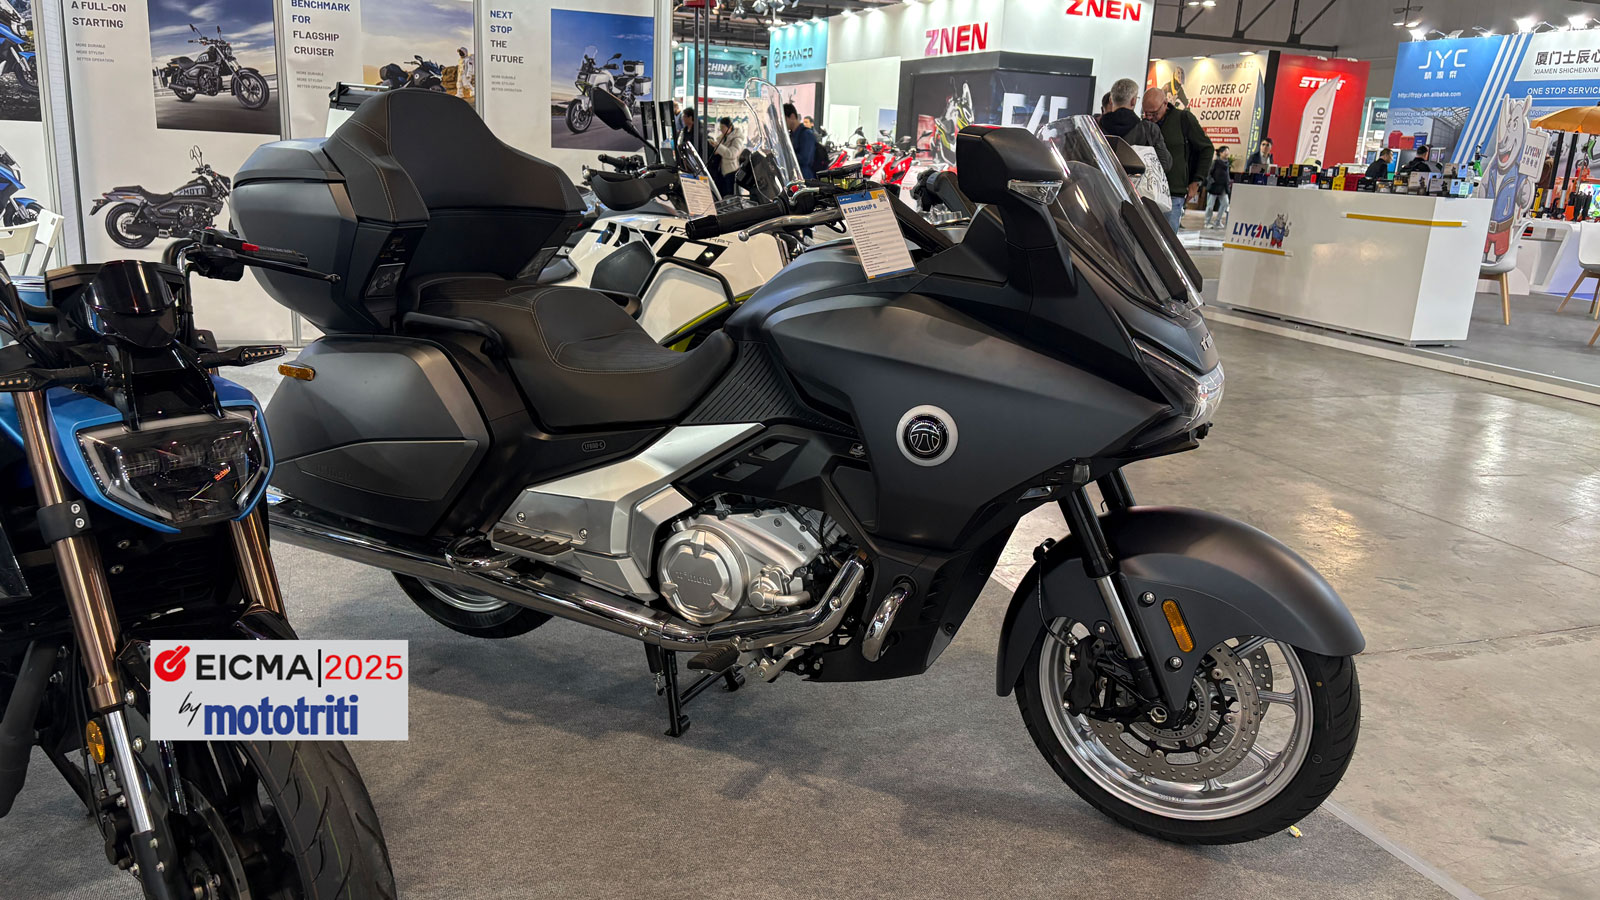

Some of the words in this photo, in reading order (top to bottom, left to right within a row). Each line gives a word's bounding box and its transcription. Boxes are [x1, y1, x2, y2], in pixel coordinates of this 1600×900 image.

[71, 1, 79, 9] A
[81, 1, 126, 12] FULL-ON
[291, 0, 350, 12] BENCHMARK
[1065, 0, 1142, 21] ZNEN
[292, 15, 311, 24] FOR
[490, 10, 513, 19] NEXT
[72, 17, 124, 28] STARTING
[490, 25, 513, 34] STOP
[293, 30, 340, 41] FLAGSHIP
[924, 22, 988, 57] ZNEN
[490, 40, 507, 48] THE
[294, 46, 335, 57] CRUISER
[491, 54, 524, 64] FUTURE
[1418, 48, 1469, 69] JYC
[1534, 67, 1558, 75] XIAMEN
[1559, 66, 1599, 74] SHICHENXIN
[1200, 84, 1237, 95] PIONEER
[1238, 83, 1252, 94] OF
[1527, 87, 1544, 95] ONE
[1545, 87, 1566, 95] STOP
[1188, 97, 1243, 108] ALL-TERRAIN
[1200, 110, 1241, 120] SCOOTER
[848, 204, 872, 213] STARSHIP
